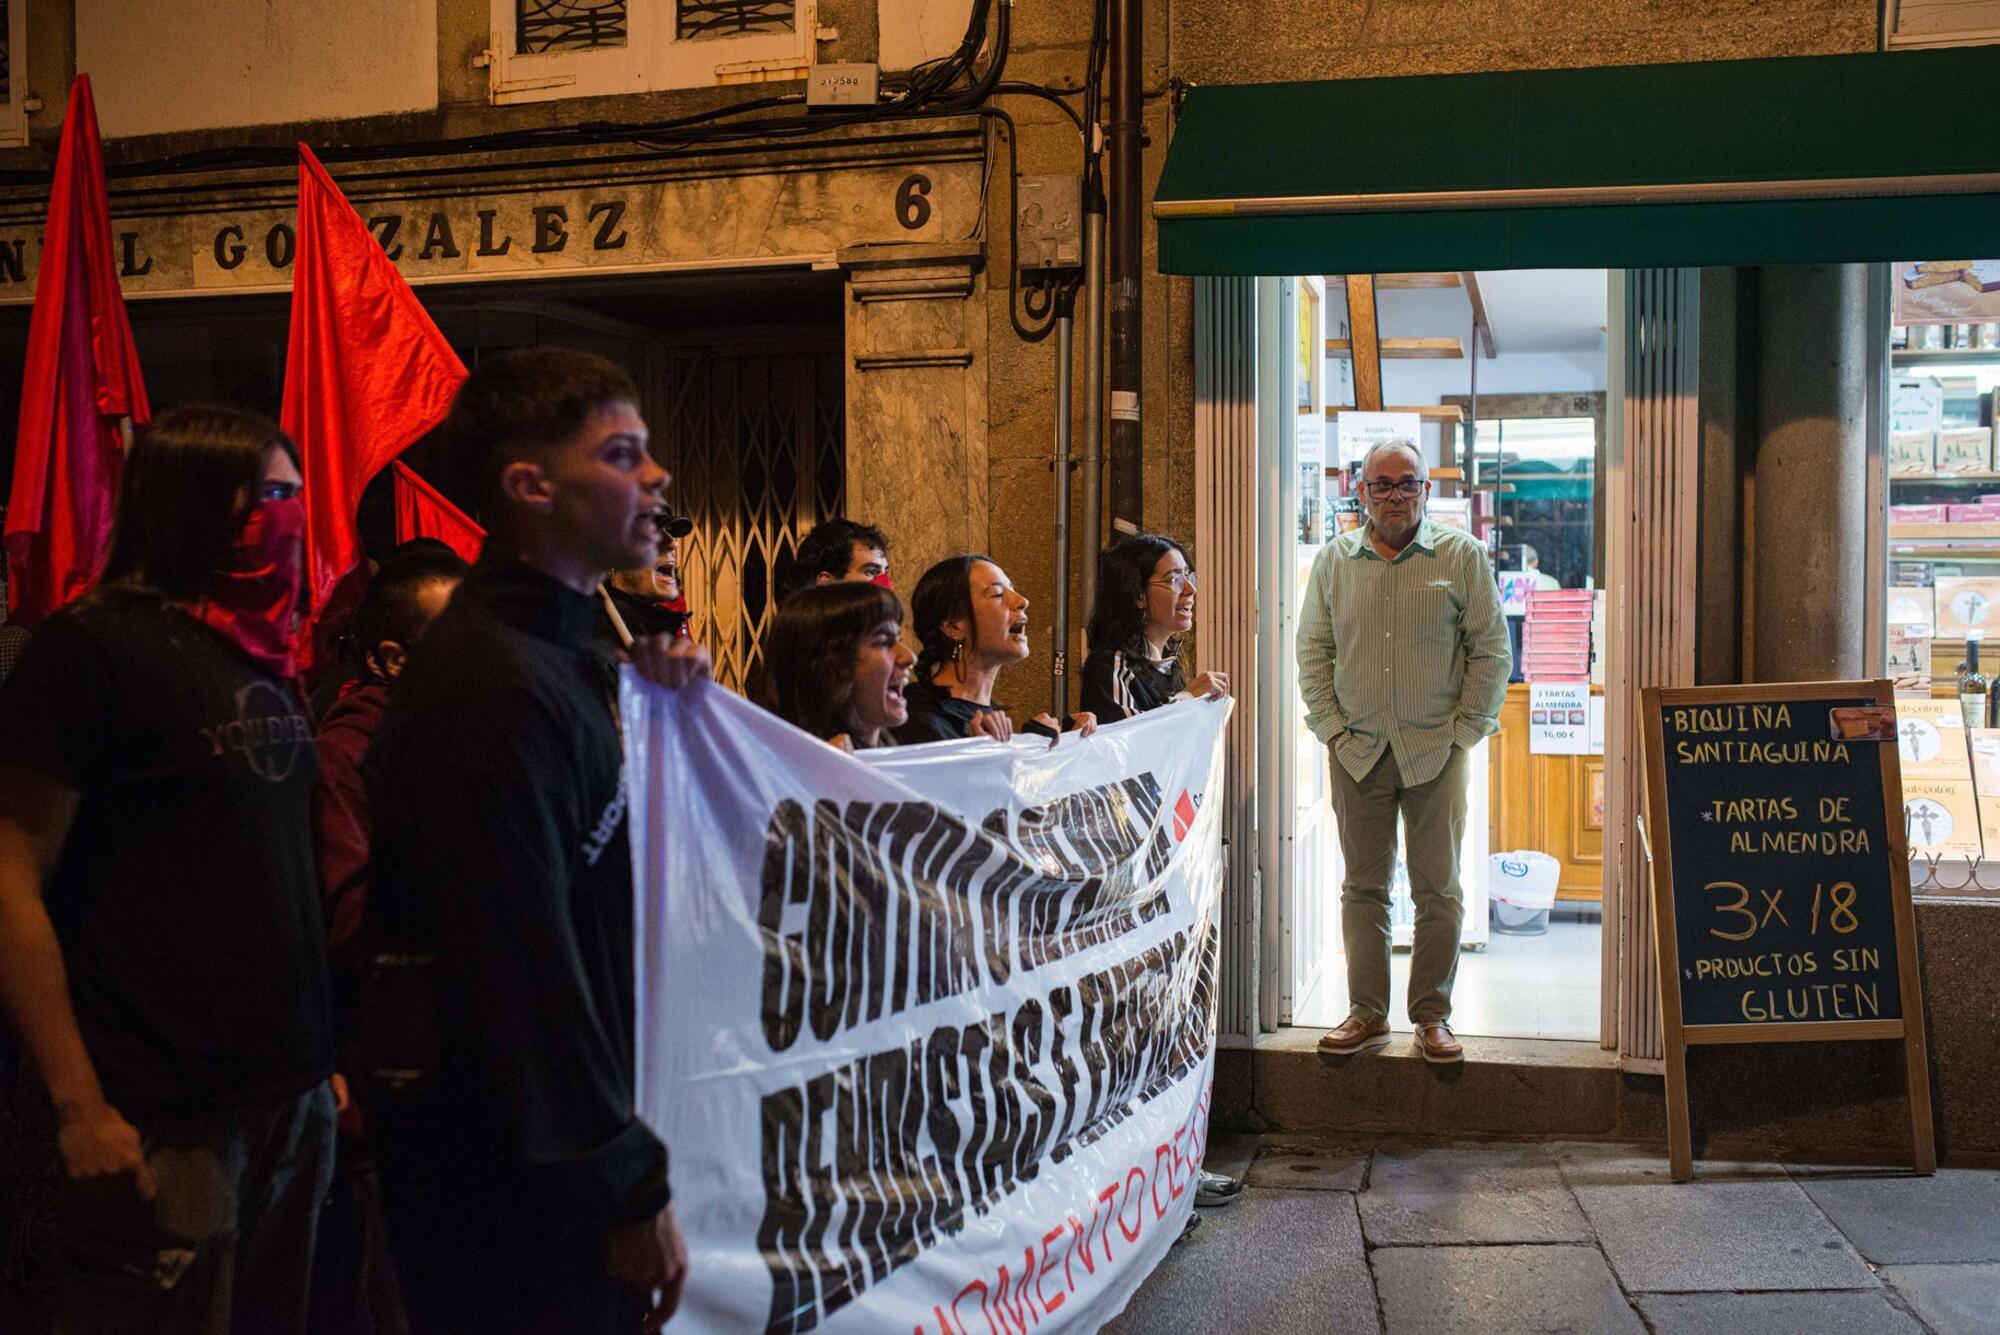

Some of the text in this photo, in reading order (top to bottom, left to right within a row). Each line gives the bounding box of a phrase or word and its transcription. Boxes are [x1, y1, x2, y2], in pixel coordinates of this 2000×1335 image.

[895, 173, 932, 230] 6
[213, 200, 629, 271] GOZALEZ
[1674, 704, 1792, 733] BIQUIÑA
[1677, 738, 1850, 764] SANTIAGUIÑA
[1712, 797, 1851, 823] TARTAS DE
[1731, 827, 1871, 855] ALMENDRA
[759, 798, 980, 1052] CONTRA
[1811, 881, 1859, 936] 18
[1832, 948, 1880, 971] SIN
[1742, 983, 1879, 1021] GLUTEN
